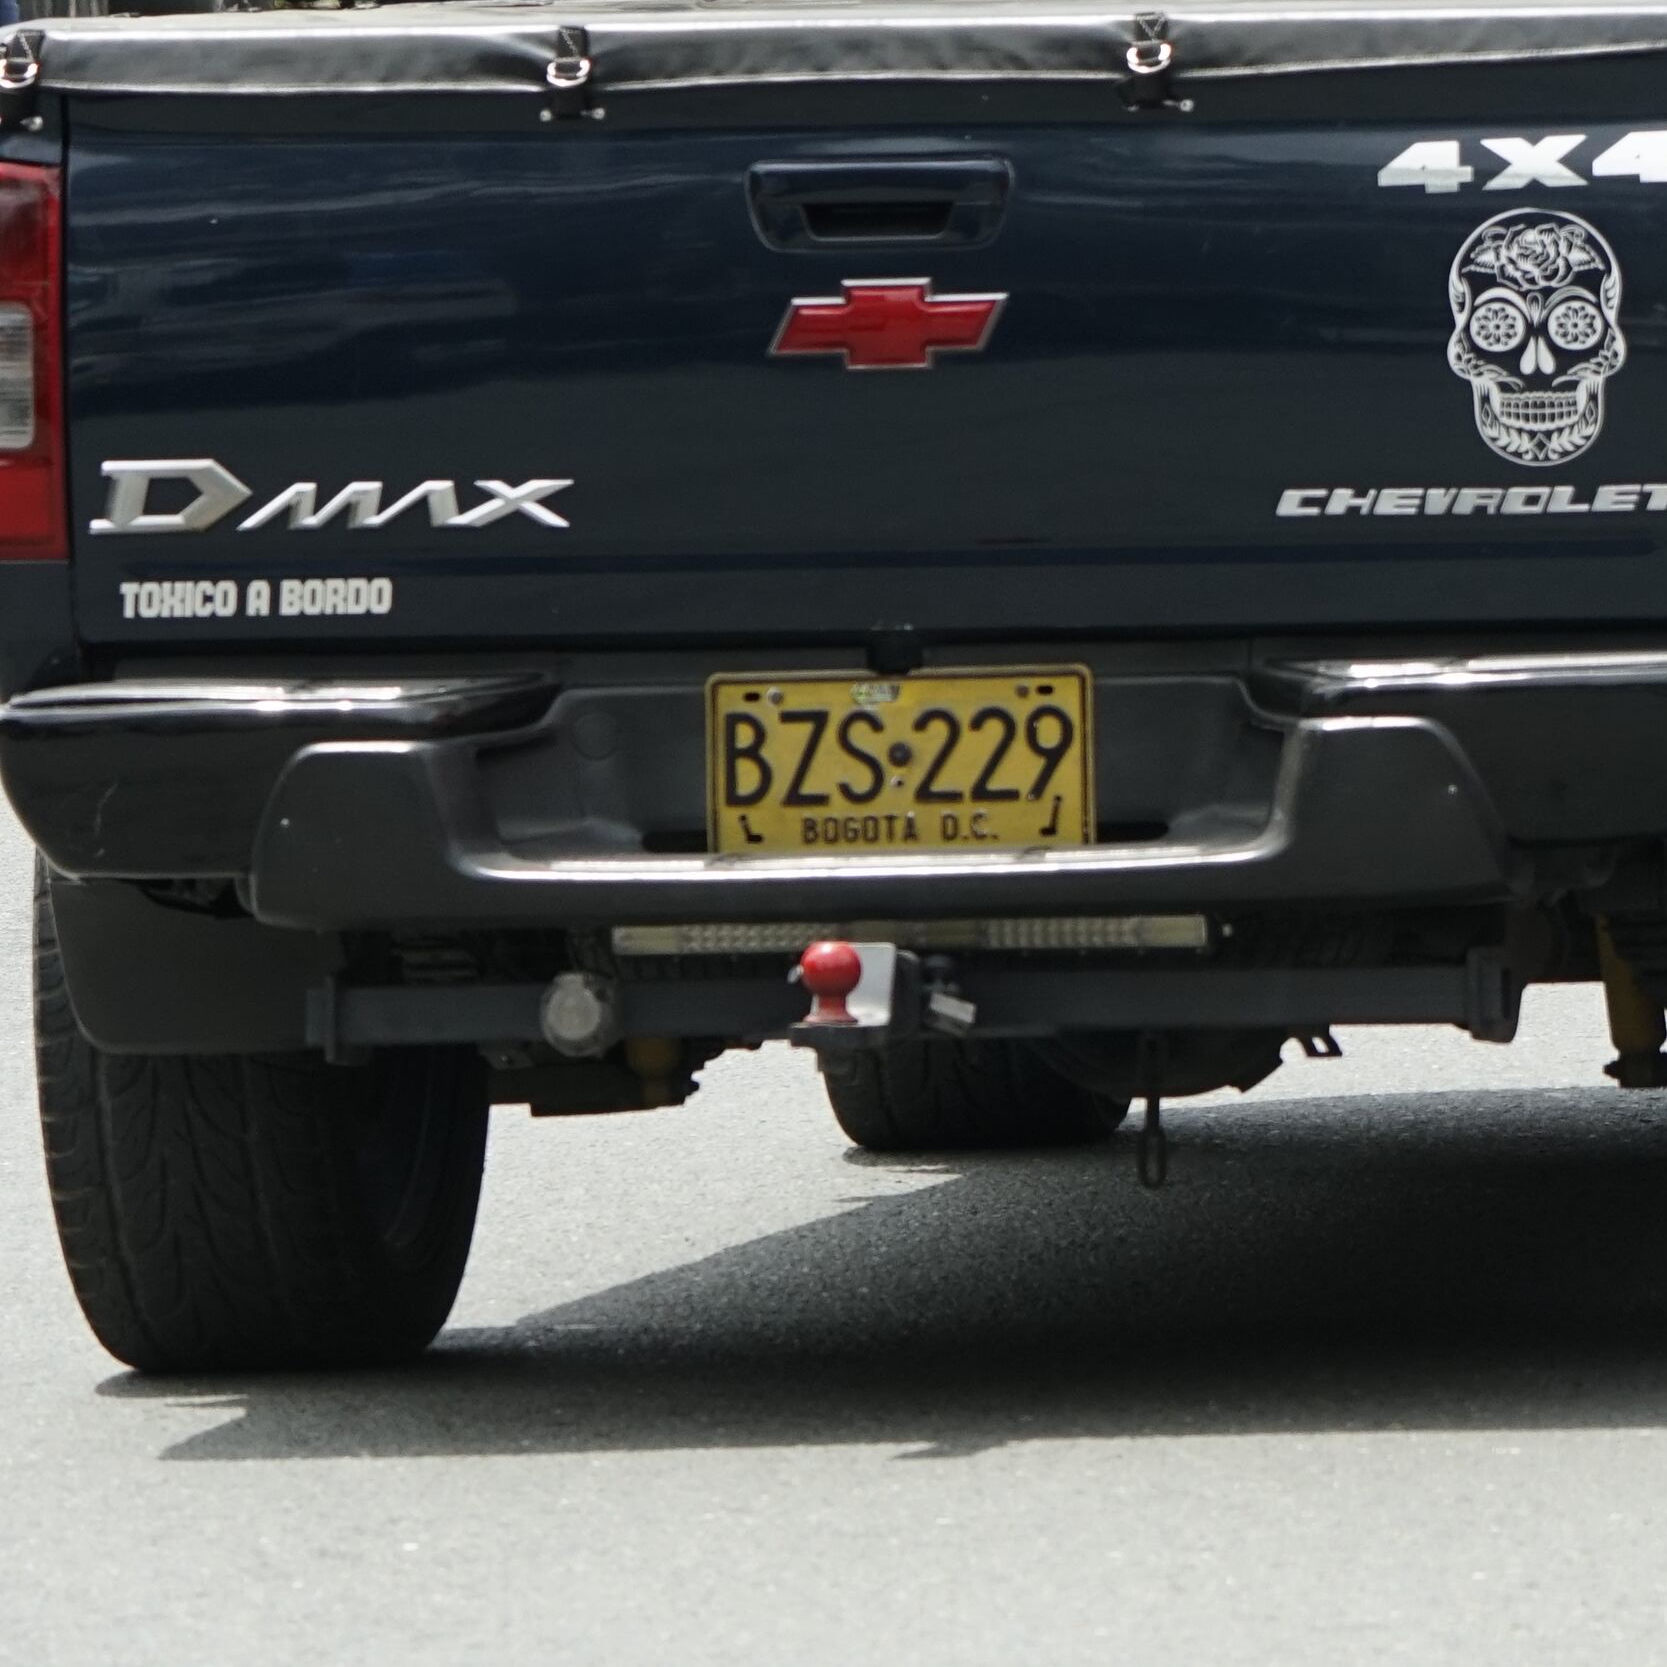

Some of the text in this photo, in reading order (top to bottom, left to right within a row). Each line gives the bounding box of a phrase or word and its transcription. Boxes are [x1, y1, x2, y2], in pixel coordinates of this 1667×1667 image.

[120, 577, 393, 619] TOXICO A BORDO
[802, 811, 1000, 845] BOGOTA D.C.
